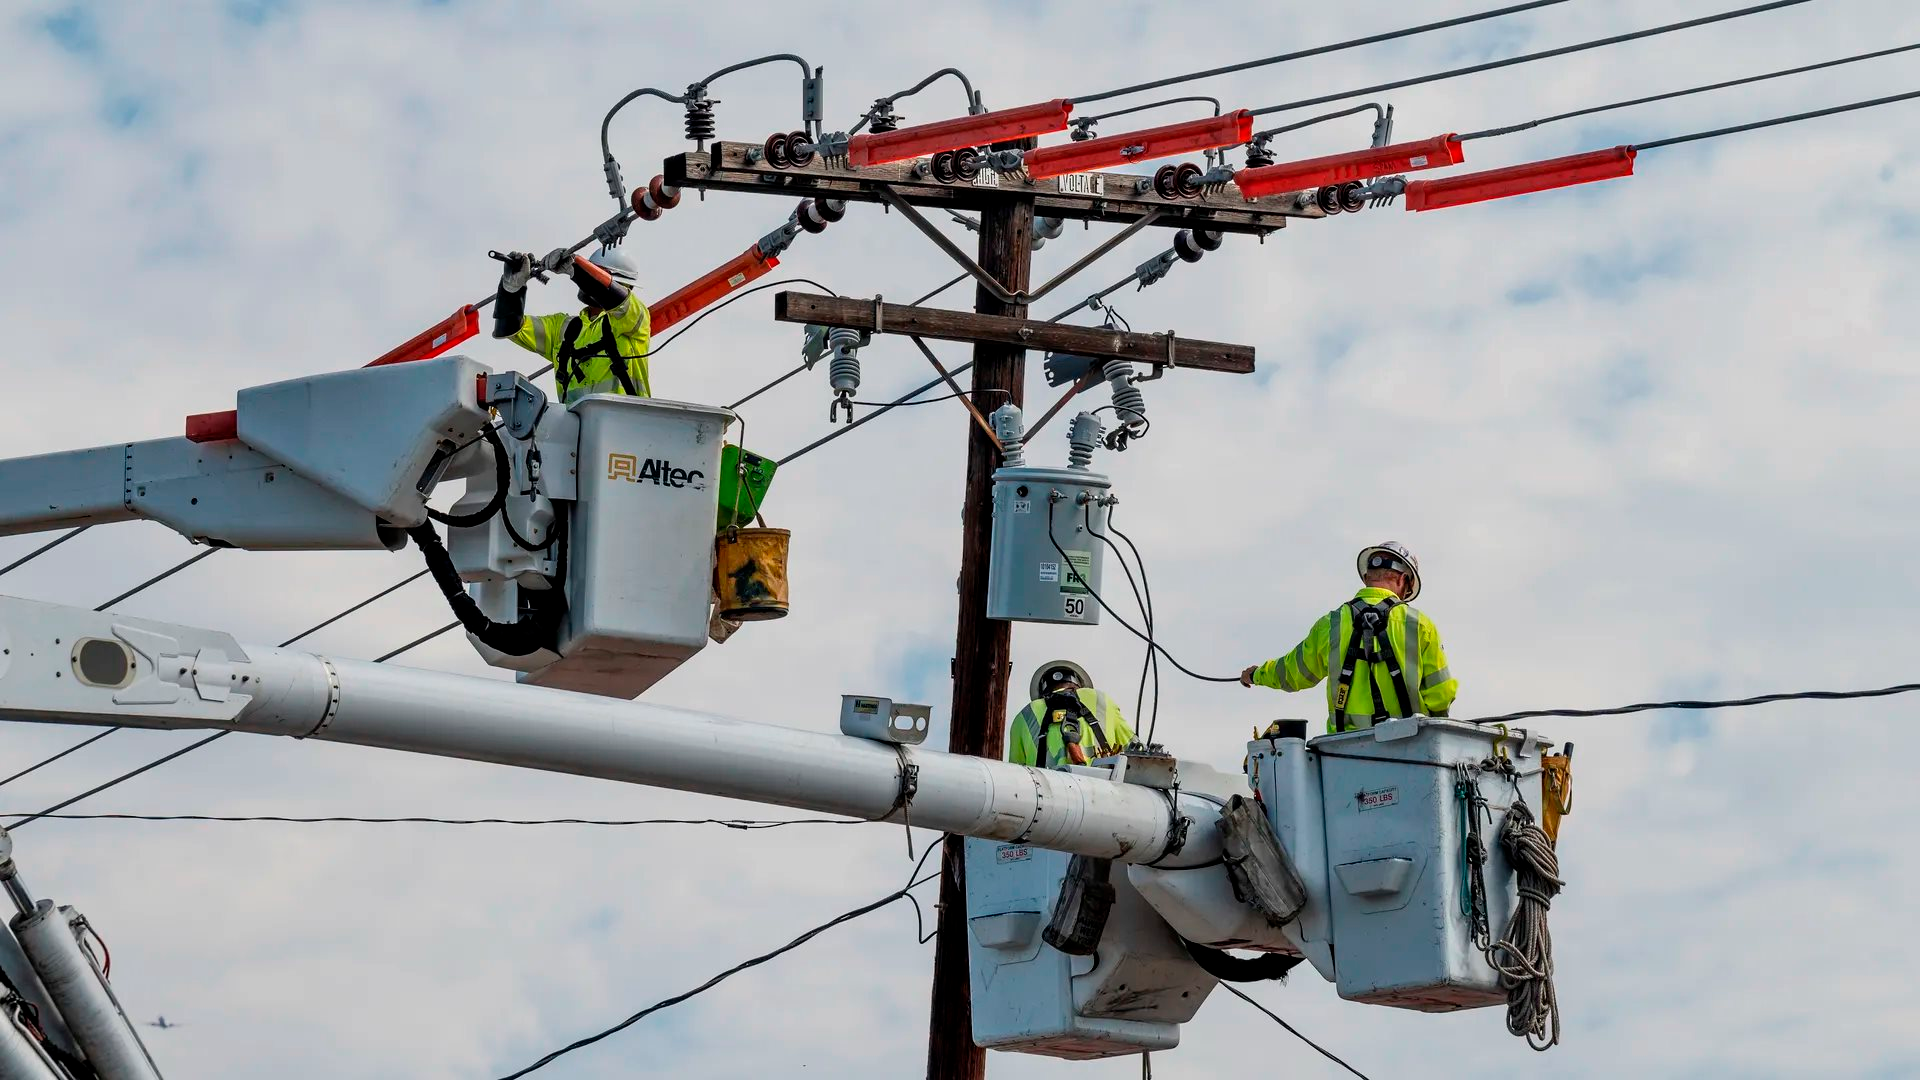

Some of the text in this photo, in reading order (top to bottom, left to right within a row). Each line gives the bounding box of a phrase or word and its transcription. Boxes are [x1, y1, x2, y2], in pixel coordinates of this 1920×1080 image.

[637, 458, 705, 490] Altec
[1065, 598, 1084, 615] 50
[1364, 795, 1378, 805] 350
[1379, 792, 1393, 802] LBS
[1001, 850, 1014, 859] 350
[1015, 848, 1028, 857] LBS
